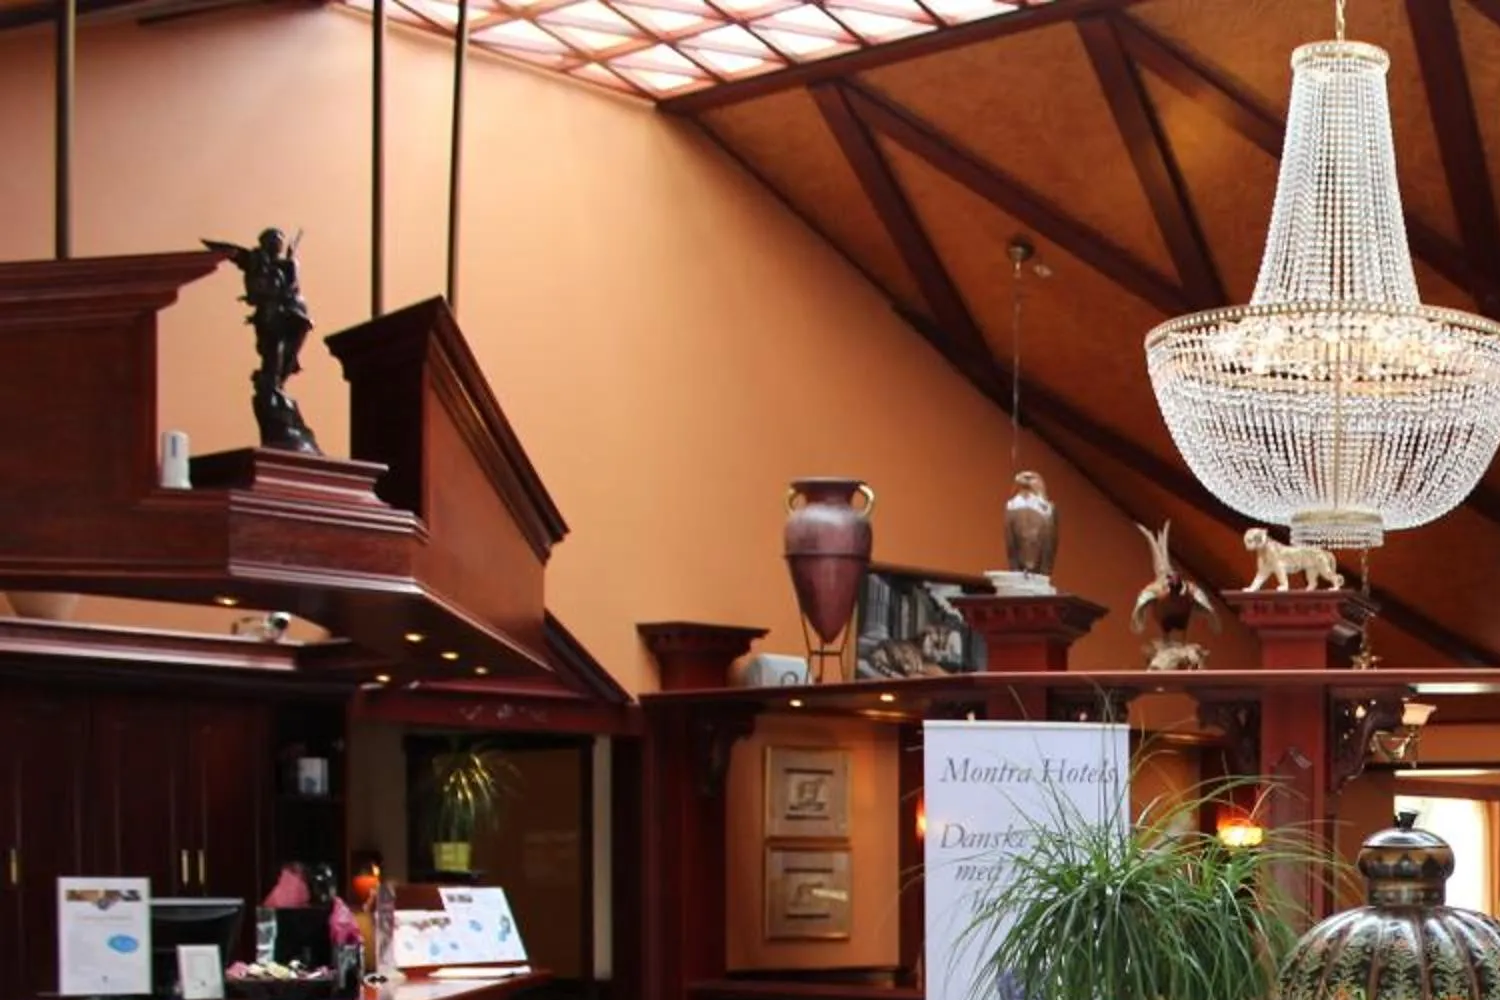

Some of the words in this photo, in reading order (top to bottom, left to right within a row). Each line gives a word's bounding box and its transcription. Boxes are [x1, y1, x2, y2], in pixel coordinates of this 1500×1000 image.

[939, 756, 1032, 784] Montra
[1042, 756, 1117, 785] Hotels
[939, 822, 1027, 850] Danske
